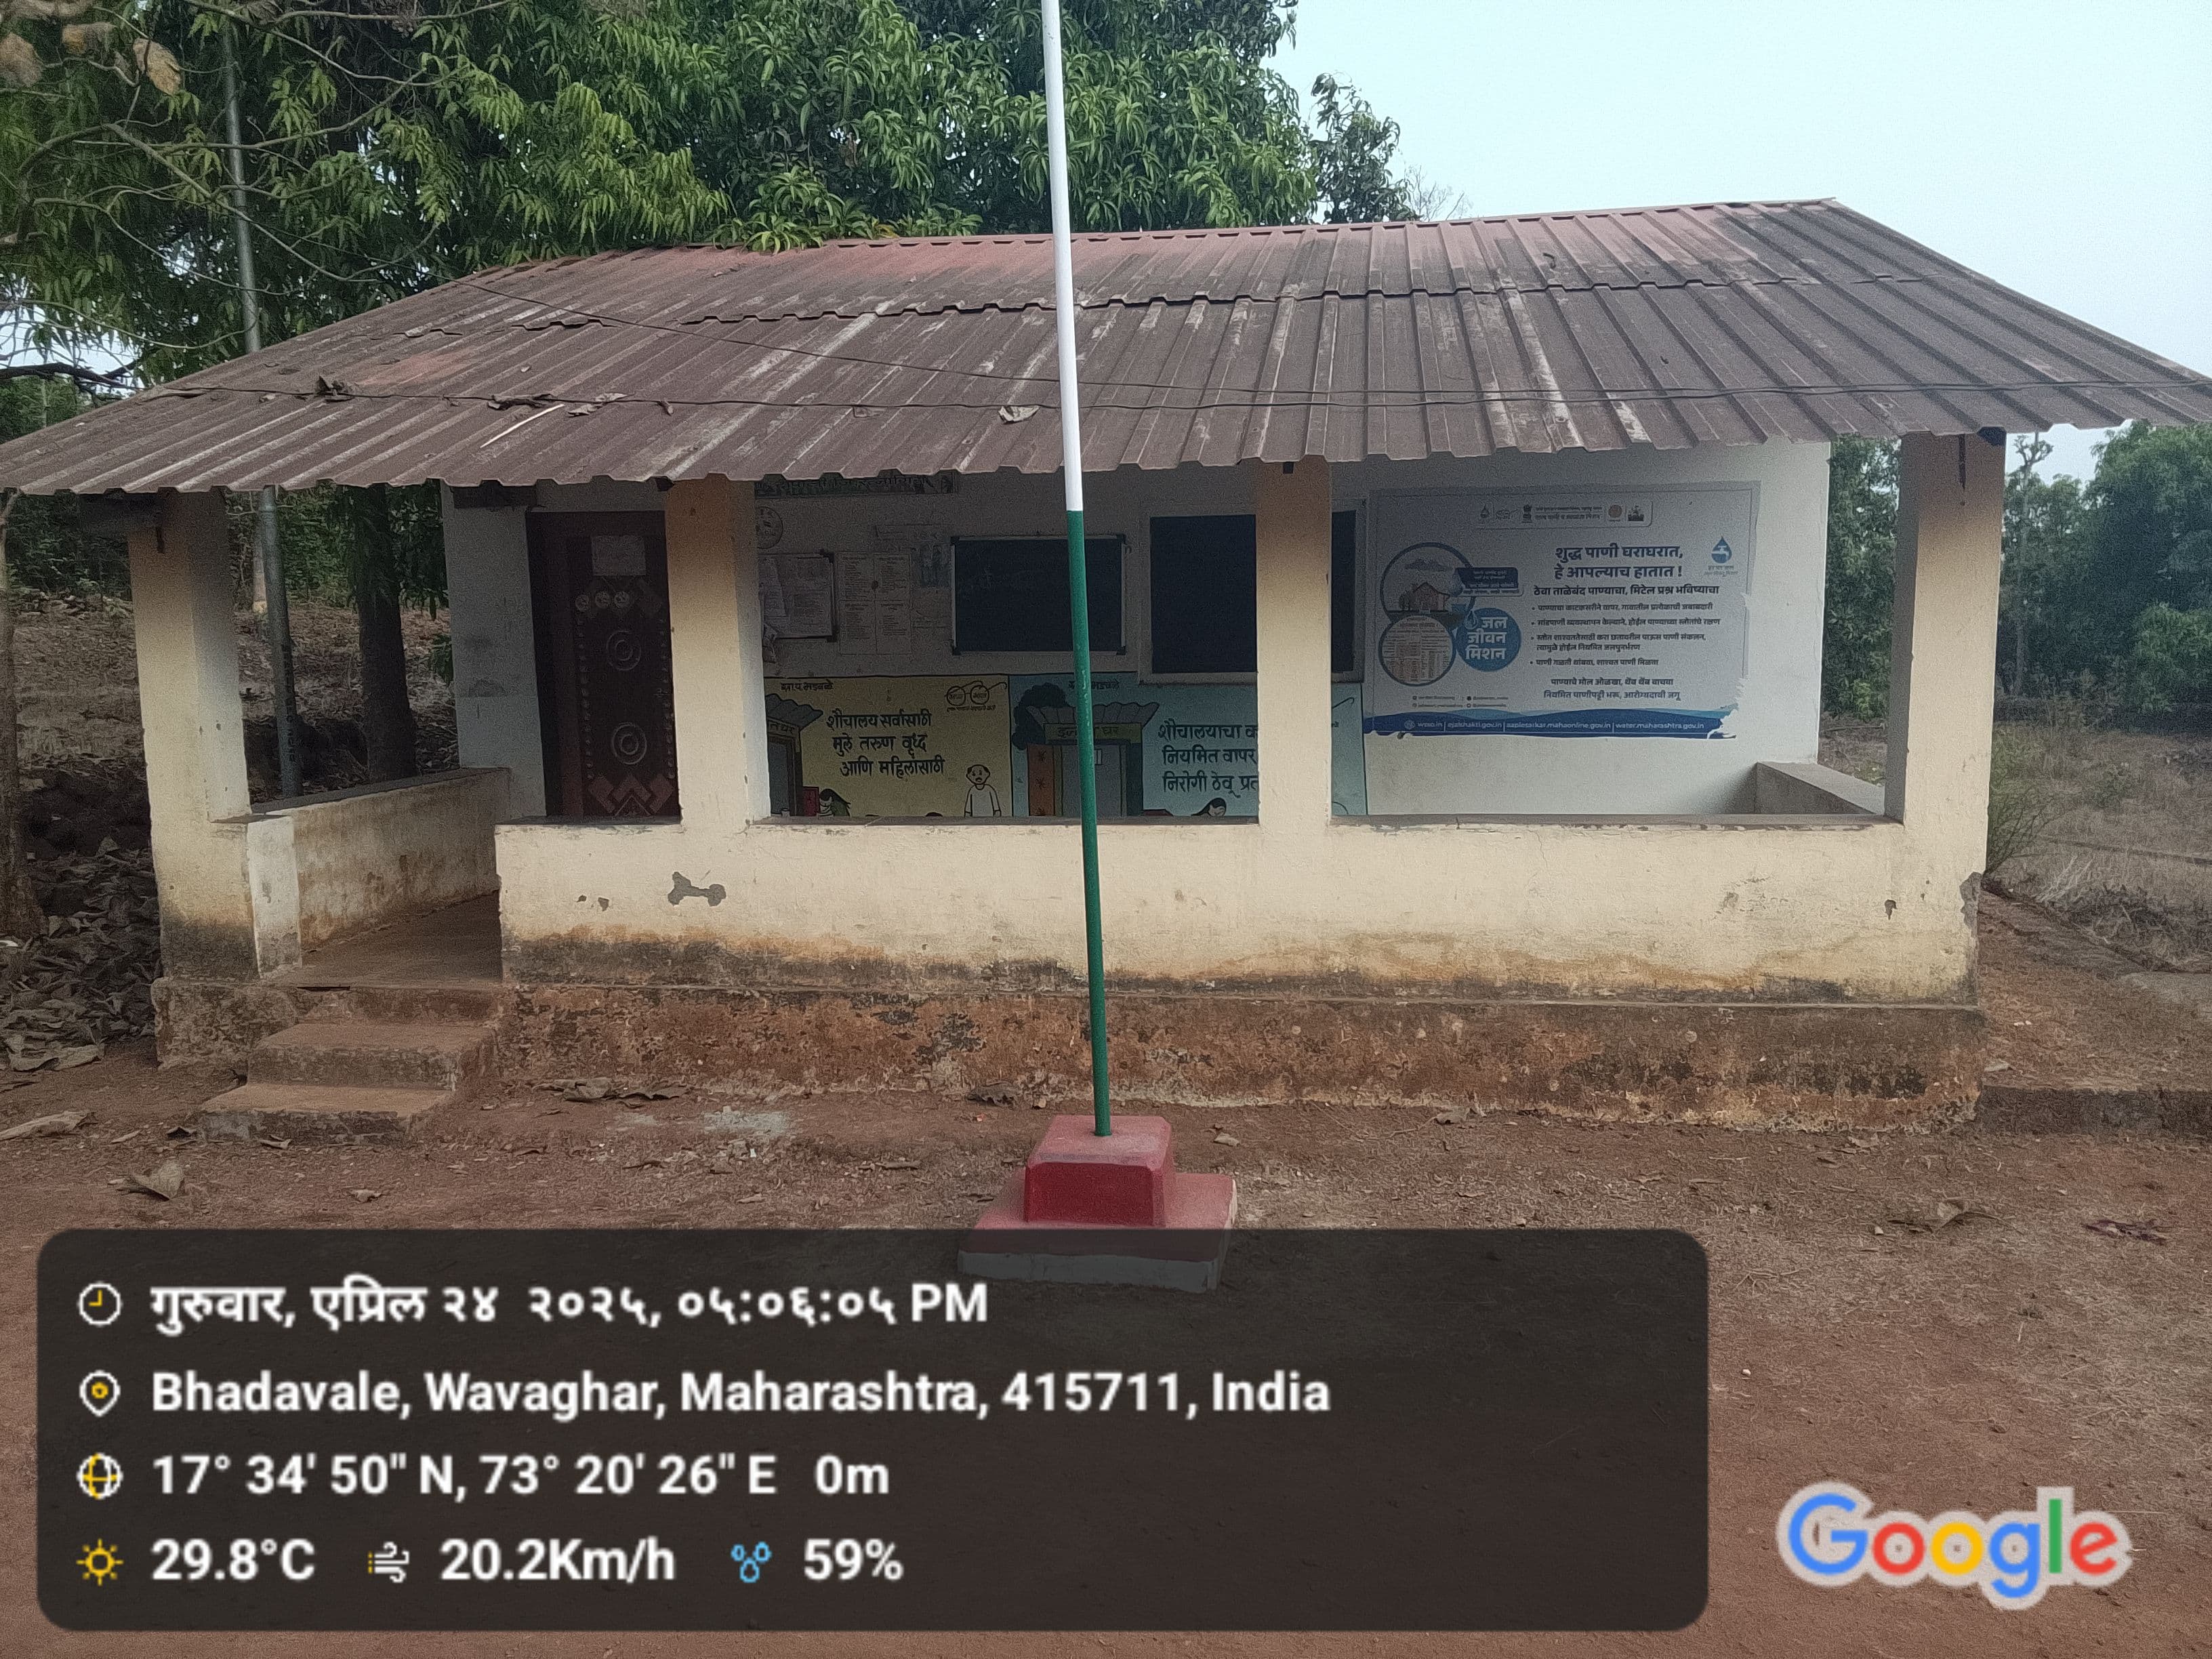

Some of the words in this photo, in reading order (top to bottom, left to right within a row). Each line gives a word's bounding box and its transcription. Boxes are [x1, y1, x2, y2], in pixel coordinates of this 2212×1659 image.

[1555, 547, 1582, 563] शुद्ध
[1585, 543, 1618, 558] पाणी
[1622, 546, 1683, 559] घराघरात,
[1553, 564, 1563, 579] हे
[1567, 566, 1631, 578] आपल्याच
[1634, 565, 1675, 579] हातात
[1533, 584, 1551, 596] ठेवा
[1553, 584, 1586, 595] ताळेबंद
[1588, 586, 1627, 596] पाण्याचा,
[1630, 583, 1656, 595] मिटेल
[1675, 583, 1720, 594] भविष्याचा
[1481, 617, 1509, 629] जल
[1467, 628, 1508, 644] जीवन
[1465, 644, 1507, 660] मिशन
[1544, 690, 1572, 699] नियमित
[826, 708, 878, 731] शौचालय
[1158, 718, 1242, 741] शौचालयाचा
[832, 733, 853, 756] मुले
[859, 735, 896, 751] तरुण
[1162, 743, 1221, 766] नियमित
[1222, 748, 1258, 764] वापर
[840, 754, 874, 777] आणि
[1162, 770, 1208, 793] निरोगी
